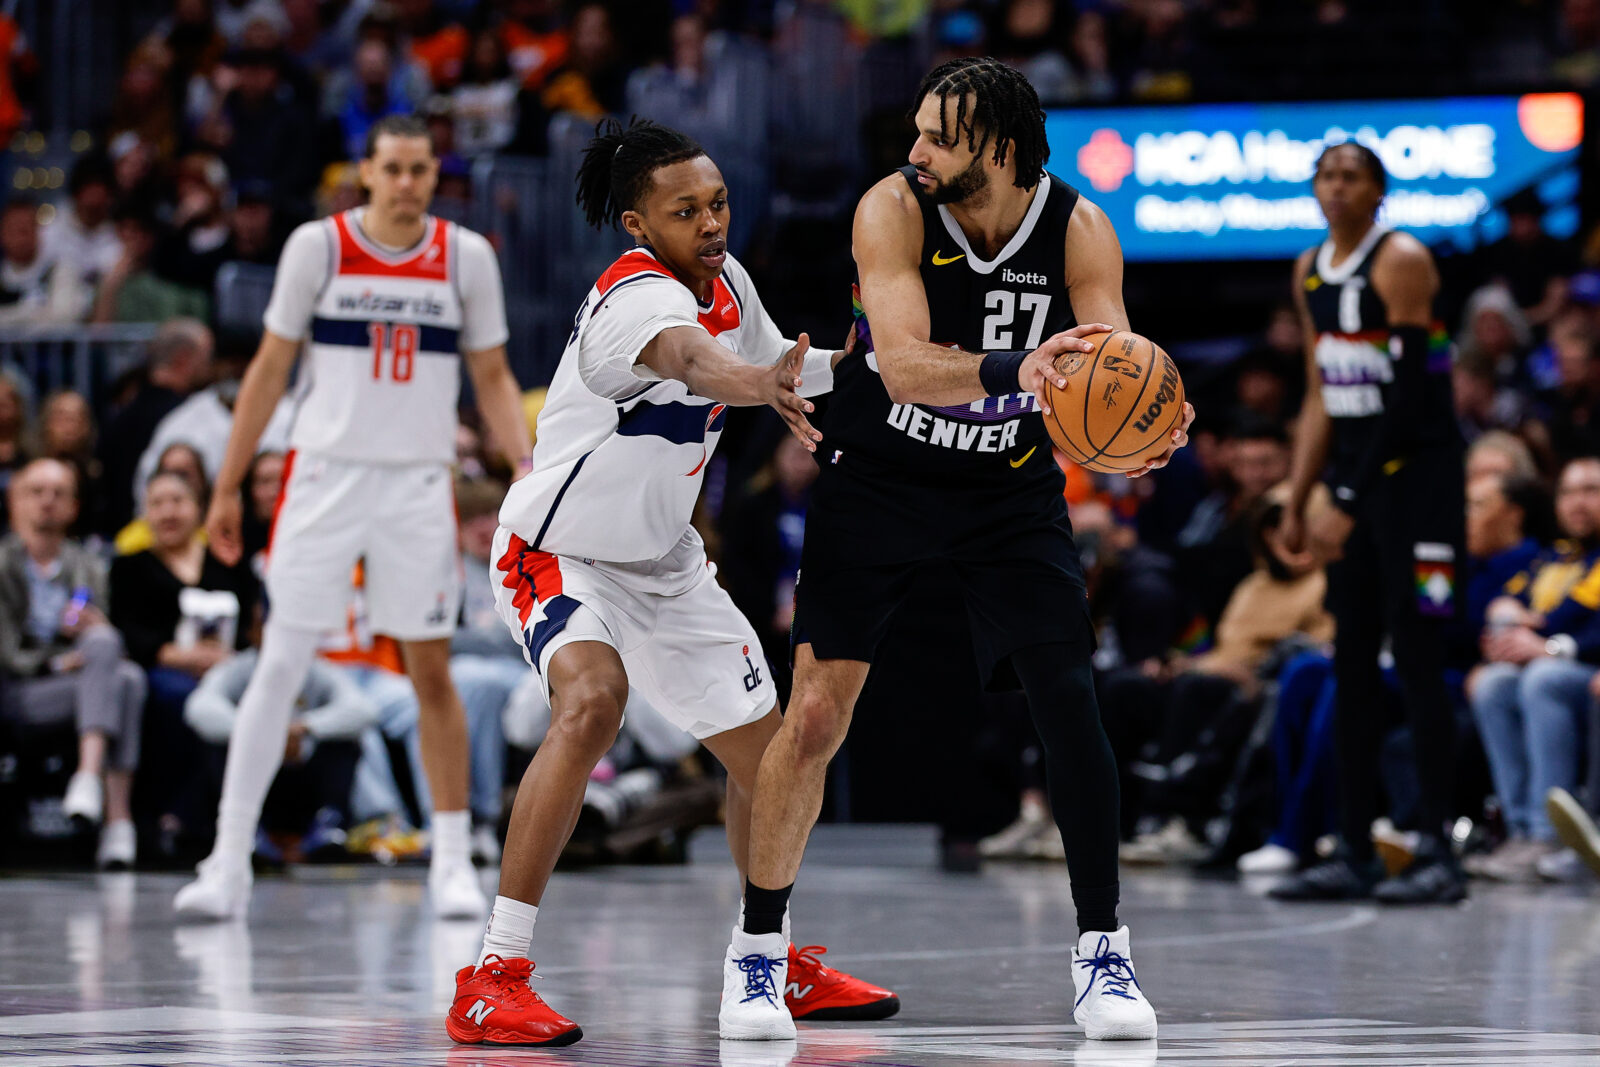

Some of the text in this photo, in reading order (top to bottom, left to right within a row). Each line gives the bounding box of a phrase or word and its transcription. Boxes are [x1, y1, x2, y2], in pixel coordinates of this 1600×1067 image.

[1002, 268, 1048, 286] ibotta
[982, 289, 1052, 350] 27
[369, 321, 421, 386] 18
[886, 402, 1021, 453] DENVER
[465, 998, 497, 1027] N
